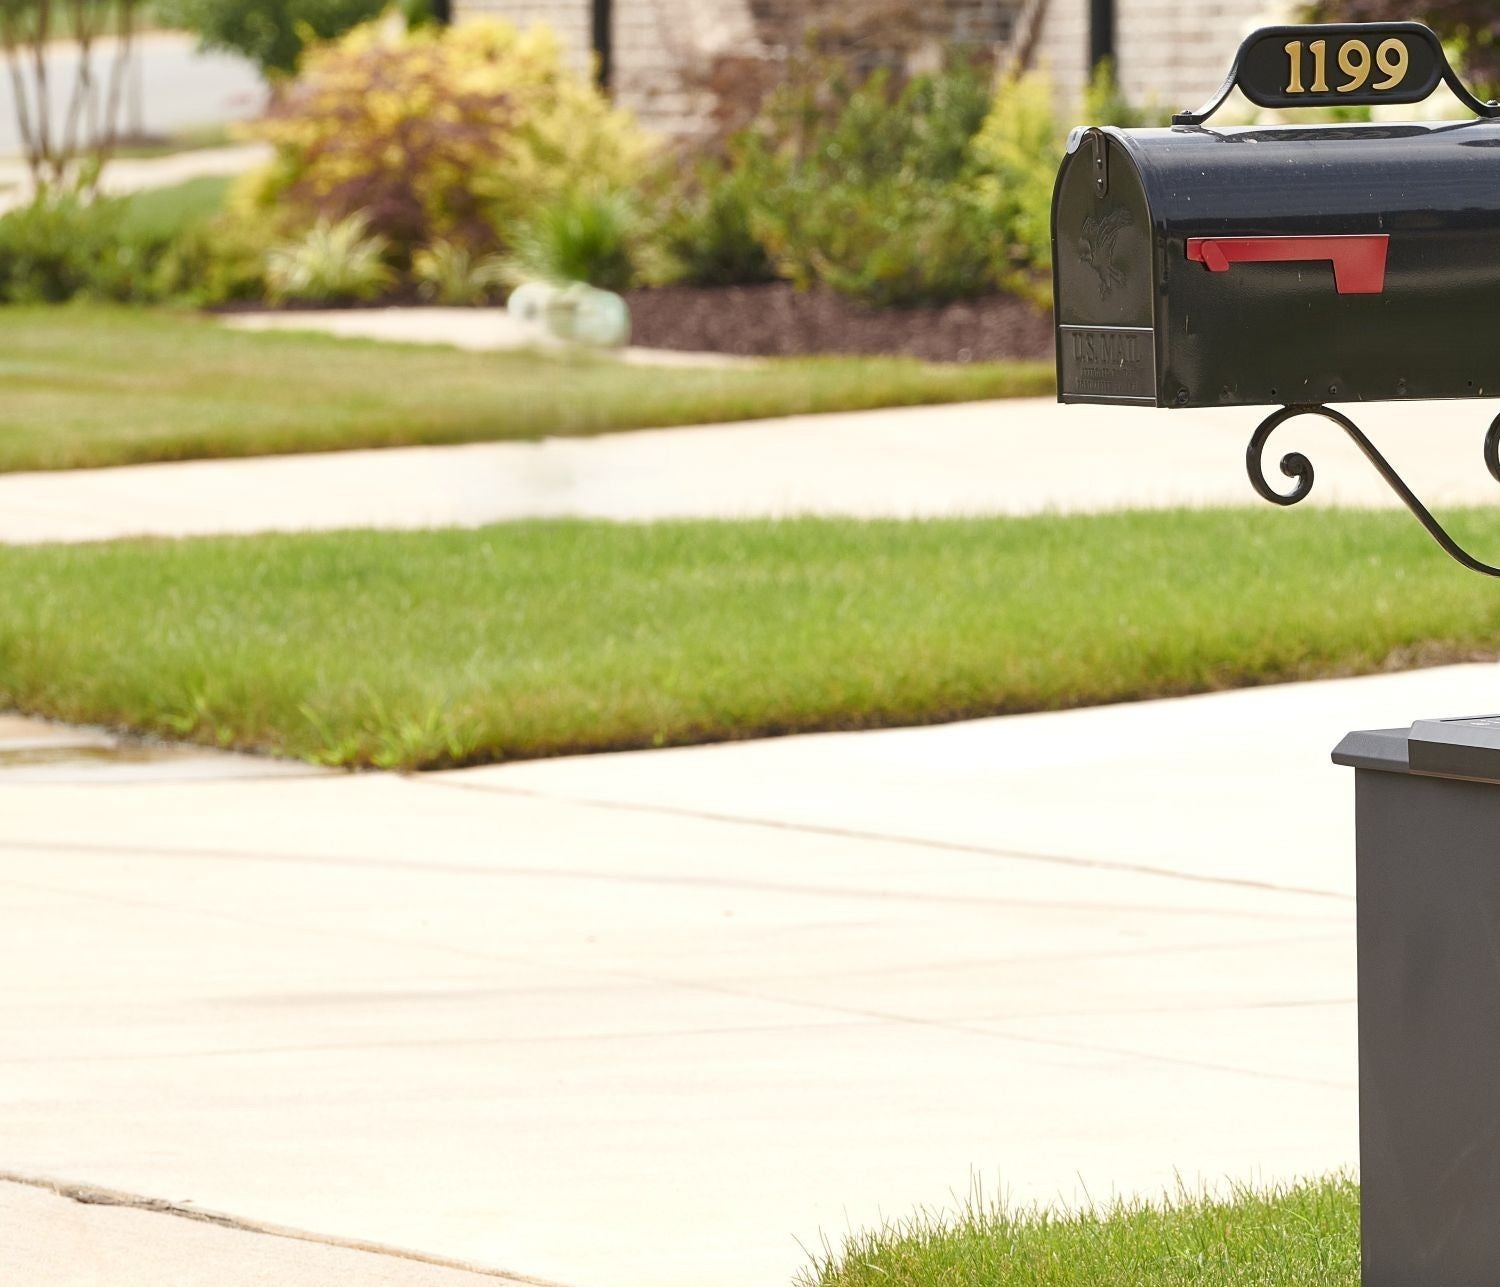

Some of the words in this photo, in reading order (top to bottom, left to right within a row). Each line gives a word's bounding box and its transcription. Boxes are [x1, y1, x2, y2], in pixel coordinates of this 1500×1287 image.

[1284, 38, 1409, 93] 1199
[1072, 332, 1098, 363] U.S.
[1101, 333, 1141, 364] MAIL
